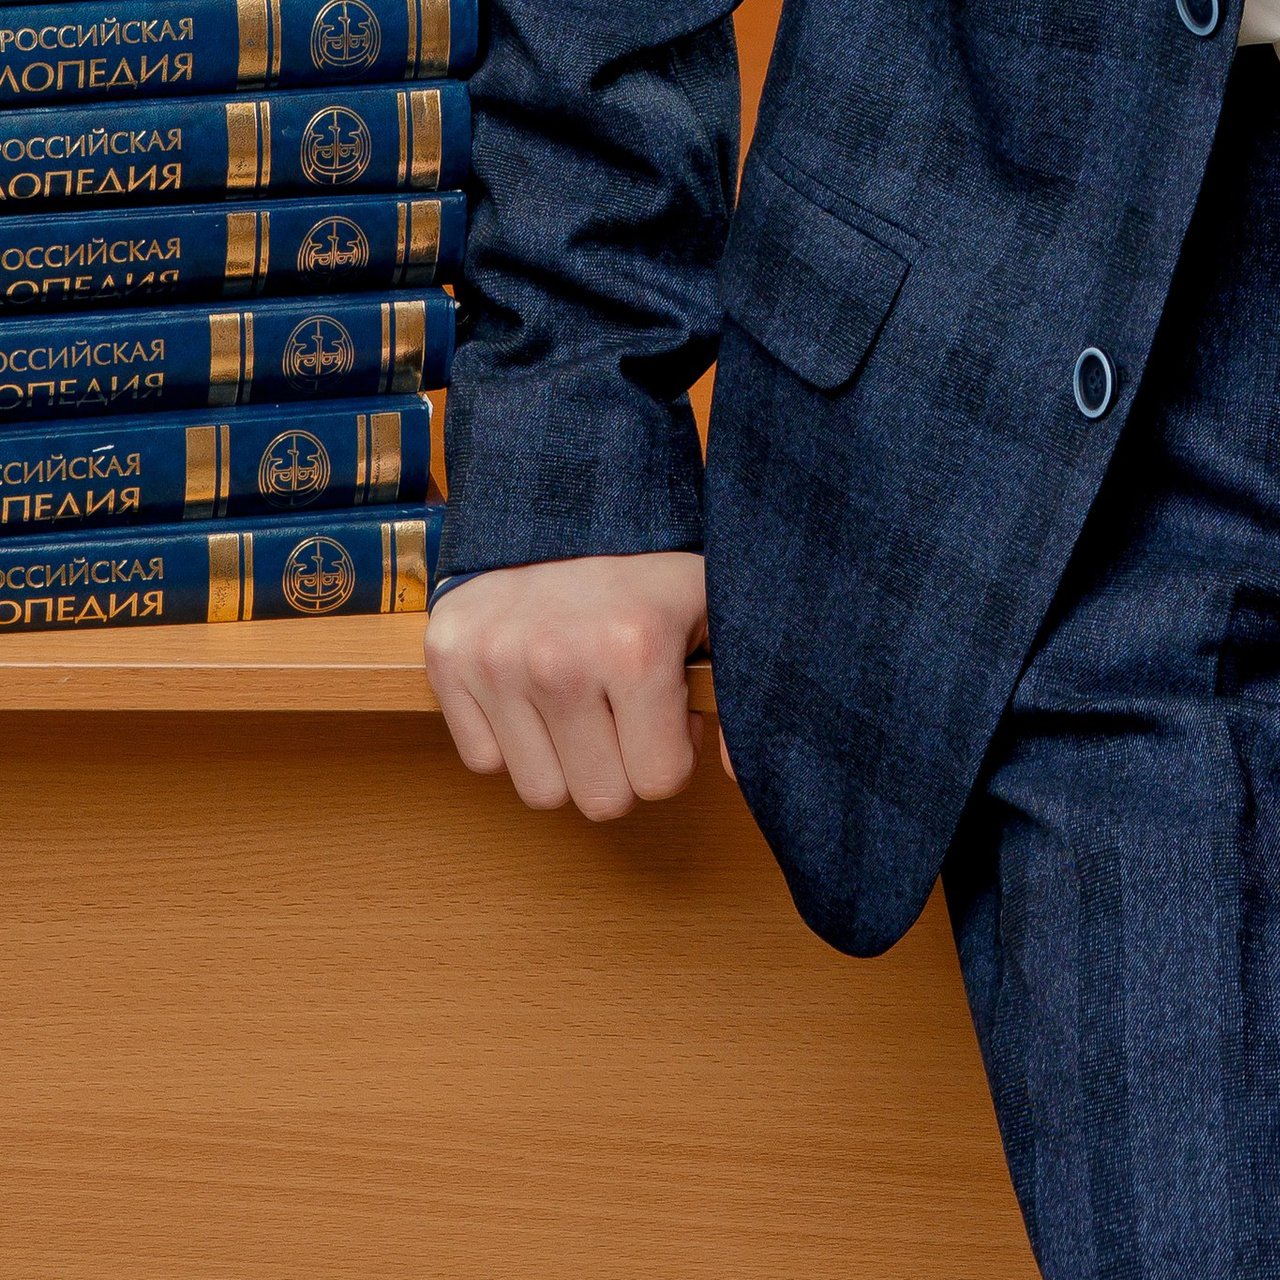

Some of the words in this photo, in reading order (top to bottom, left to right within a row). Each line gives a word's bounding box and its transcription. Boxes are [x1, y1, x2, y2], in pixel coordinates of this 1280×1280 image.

[0, 128, 183, 160] ОССИЙСКАЯ
[0, 269, 179, 305] ОПЕДИЯ
[0, 339, 165, 372] ССИЙСКАЯ
[0, 372, 165, 410] ОПЕДИЯ
[0, 452, 141, 487] СИЙСКАЯ
[1, 486, 141, 525] ПЕДИЯ
[0, 557, 164, 589] ССИЙСКАЯ
[0, 590, 164, 625] ОПЕДИЯ
